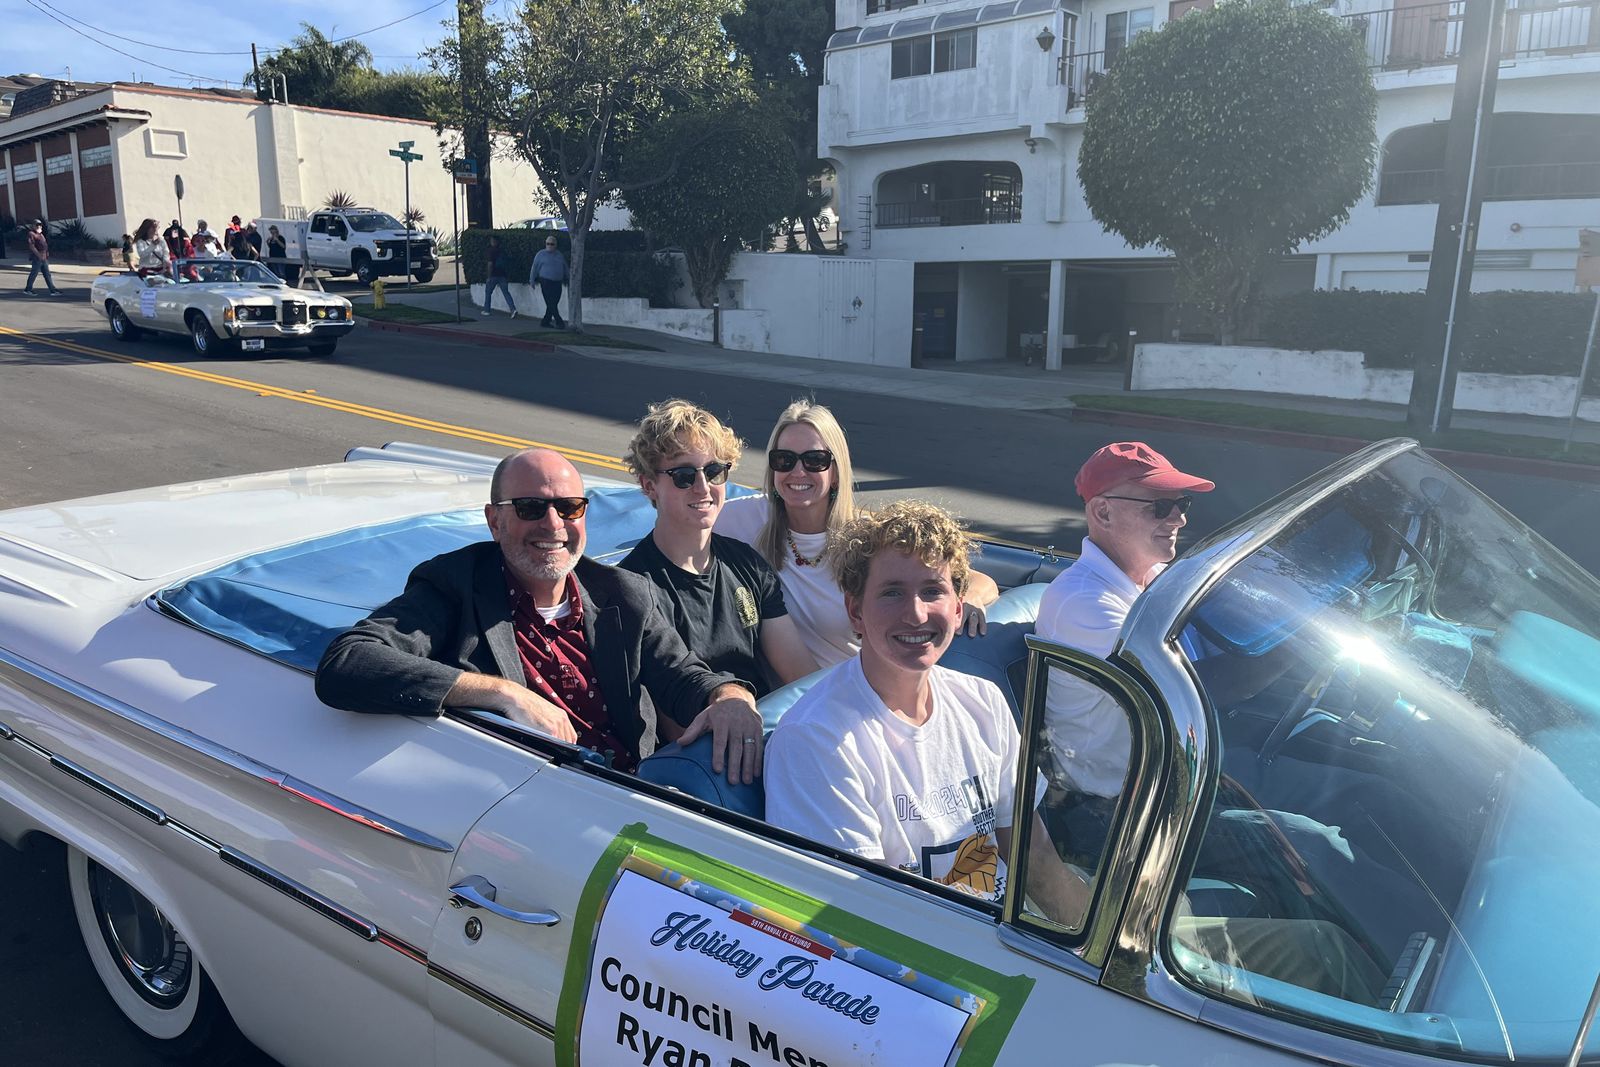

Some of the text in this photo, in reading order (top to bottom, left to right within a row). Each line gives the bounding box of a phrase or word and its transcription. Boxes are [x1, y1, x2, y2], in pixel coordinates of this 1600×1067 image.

[650, 911, 880, 1025] Holiday Parade
[763, 924, 782, 937] ANNUAL
[781, 932, 788, 940] EL
[788, 934, 812, 949] SEGUNDO
[601, 957, 734, 1042] Council
[616, 1011, 711, 1067] Ryan
